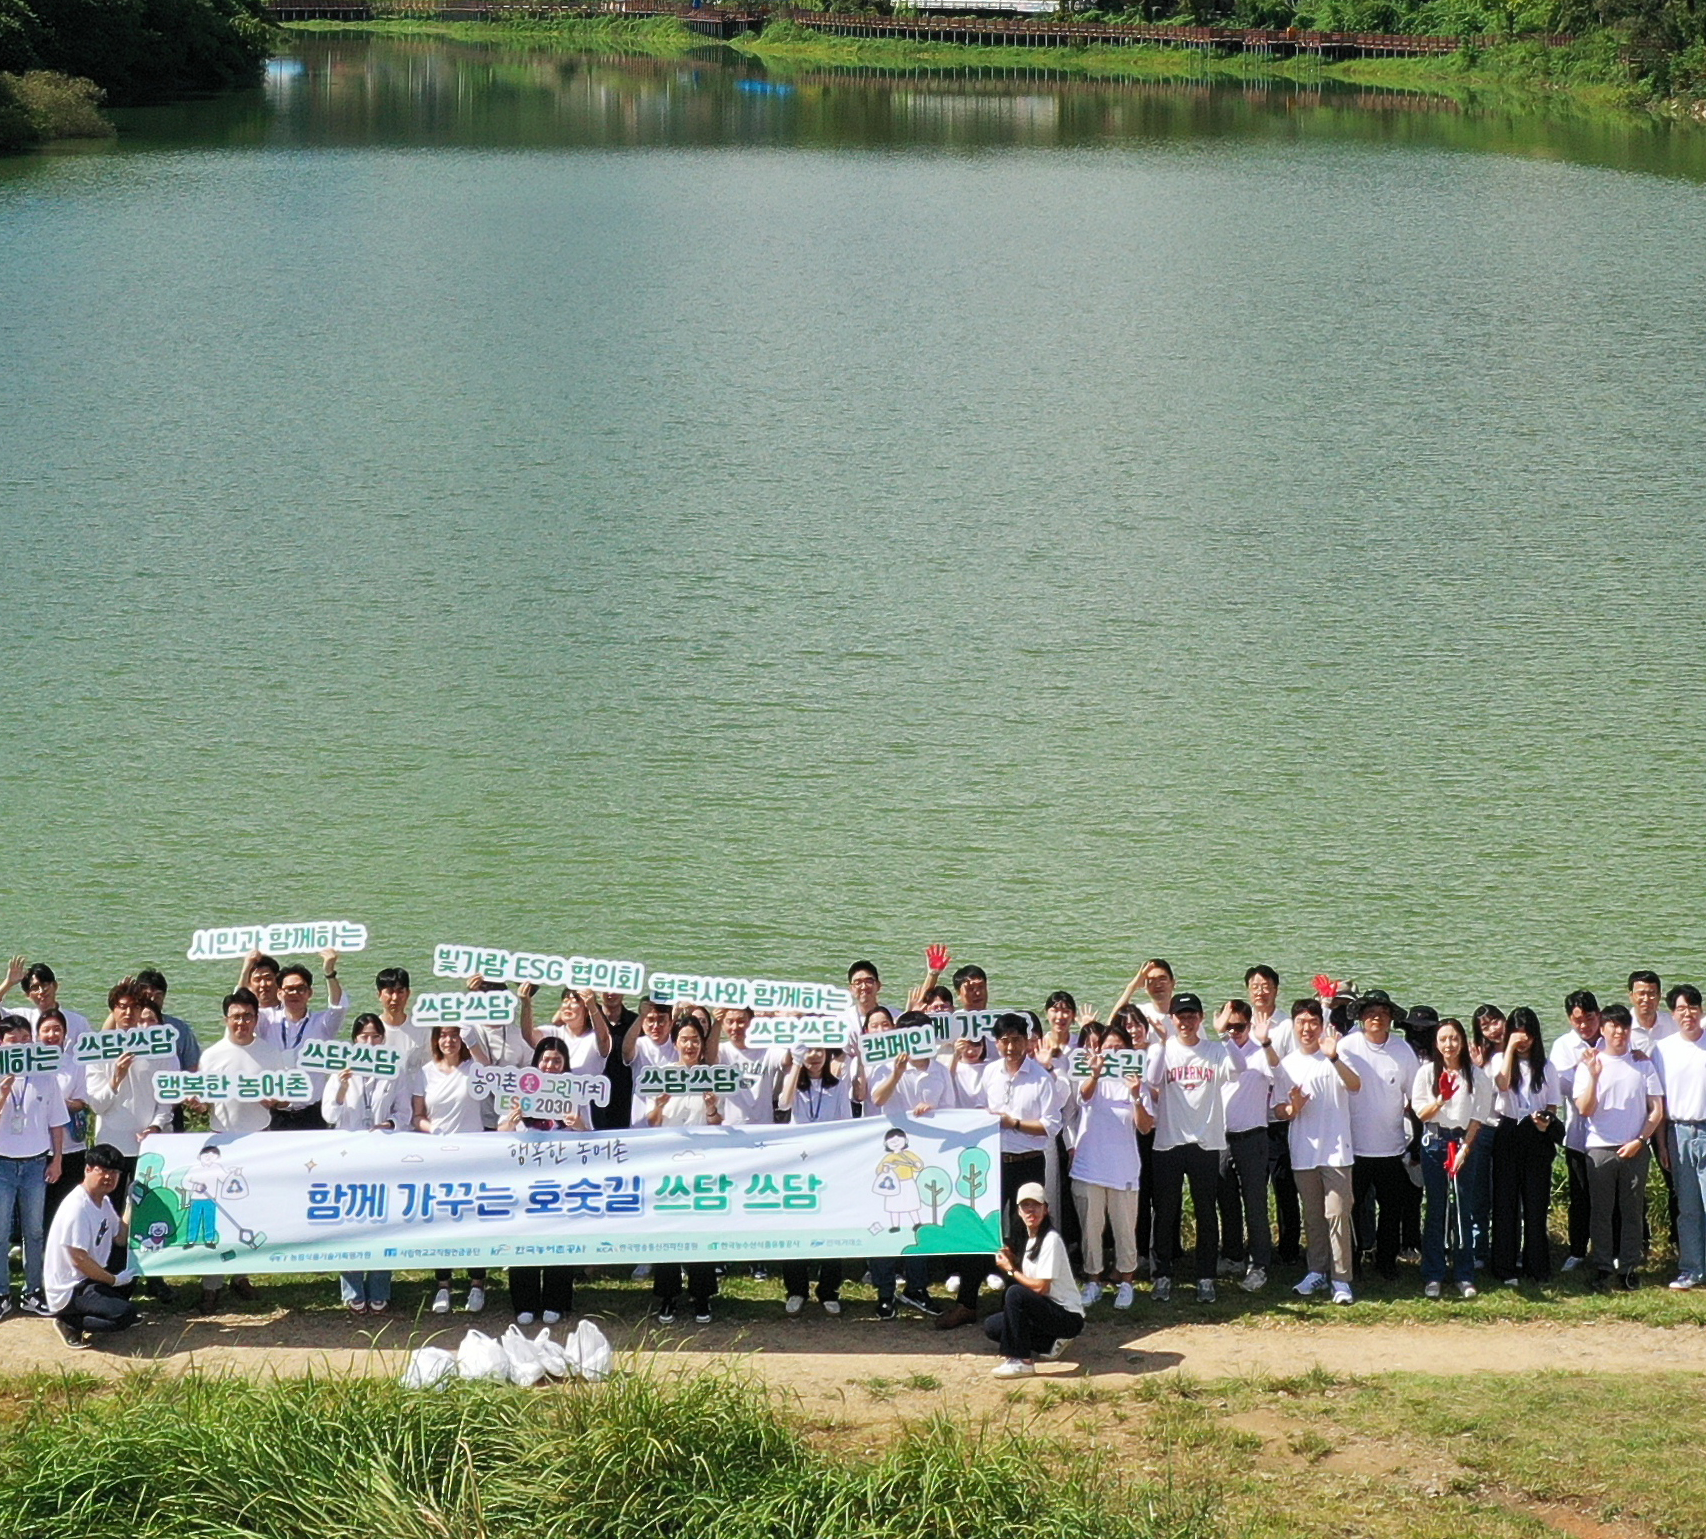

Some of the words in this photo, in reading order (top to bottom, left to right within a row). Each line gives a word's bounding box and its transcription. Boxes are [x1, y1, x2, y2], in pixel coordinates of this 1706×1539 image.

[192, 930, 263, 956] 시민과
[268, 925, 363, 952] 함께하는
[437, 948, 509, 978] 빛가람
[514, 956, 563, 981] ESG
[570, 961, 640, 991] 협의회
[416, 995, 513, 1022] 쓰담쓰담
[652, 977, 748, 1004] 협력사와
[754, 983, 848, 1012] 함께하는
[77, 1028, 175, 1061] 쓰담쓰담
[749, 1020, 848, 1044] 쓰담쓰담
[862, 1029, 933, 1063] 캠페인
[300, 1042, 401, 1075] 쓰담쓰담
[156, 1073, 231, 1099] 행복한
[237, 1073, 309, 1098] 농어촌
[640, 1068, 739, 1093] 쓰담쓰담
[499, 1095, 532, 1112] ESG
[535, 1098, 573, 1114] 2030
[507, 1141, 568, 1167] 행복한
[576, 1138, 629, 1165] 농어촌
[307, 1182, 385, 1220] 함께
[397, 1181, 514, 1217] 가꾸는
[525, 1175, 641, 1215] 호숫길
[652, 1173, 734, 1211] 쓰담
[742, 1173, 823, 1210] 쓰담
[515, 1244, 587, 1255] 한국농어촌공사
